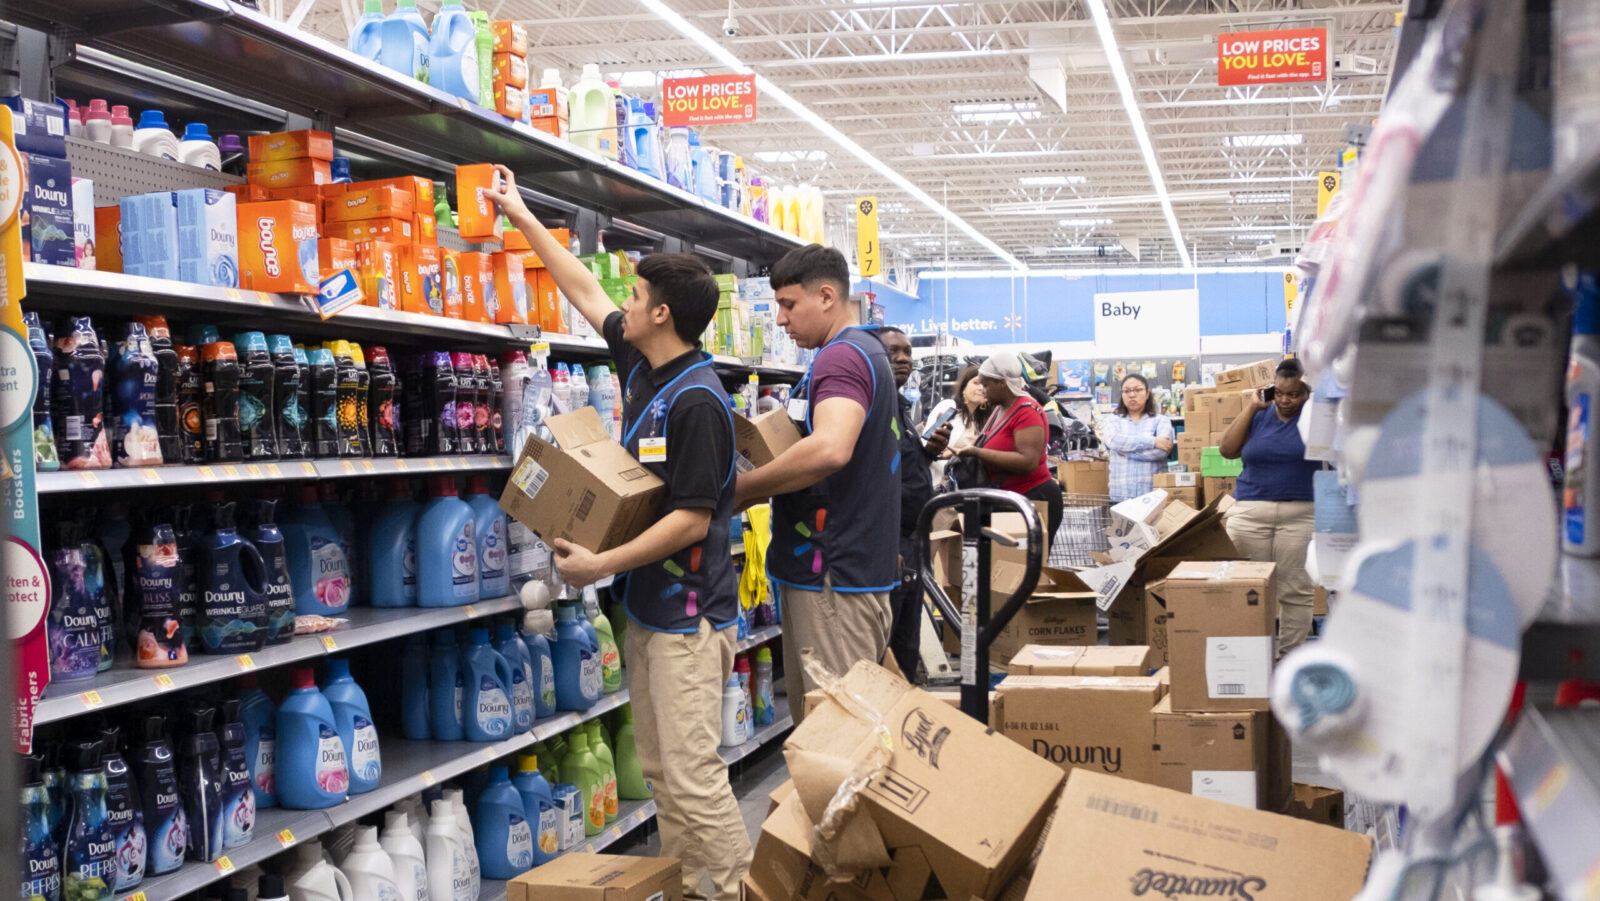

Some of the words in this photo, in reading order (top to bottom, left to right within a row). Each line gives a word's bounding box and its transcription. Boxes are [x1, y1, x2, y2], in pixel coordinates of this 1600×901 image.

[1222, 41, 1260, 56] LOW
[1263, 37, 1320, 53] PRICES
[1222, 55, 1258, 70] YOU
[1263, 52, 1310, 68] LOVE.
[667, 85, 699, 98] LOW
[702, 82, 751, 96] PRICES
[667, 98, 698, 112] YOU
[703, 97, 742, 110] LOVE.
[34, 184, 68, 208] Downy
[73, 222, 91, 238] wny
[210, 228, 235, 247] Downy
[292, 223, 317, 242] bounce
[258, 217, 281, 278] bounce
[865, 240, 873, 254] J
[417, 263, 440, 276] bounce
[864, 259, 873, 272] 7
[383, 250, 397, 310] bounce
[463, 274, 475, 305] bounce
[1101, 301, 1141, 320] Baby
[920, 319, 948, 333] Live
[951, 317, 998, 332] better.
[0, 366, 17, 377] tra
[0, 380, 19, 392] ent
[12, 448, 25, 520] Boosters
[319, 557, 346, 573] Downy
[6, 575, 29, 588] ften
[31, 575, 41, 587] &
[140, 576, 172, 589] Downy
[7, 590, 39, 603] otect
[143, 591, 171, 603] BLISS
[204, 589, 245, 604] Downy
[205, 603, 266, 617] WRINKLEGUARD
[63, 614, 97, 628] Downy
[1028, 626, 1052, 637] CORN
[1054, 624, 1087, 636] FLAKES
[63, 631, 100, 649] CALM
[479, 702, 510, 715] Downy
[17, 697, 31, 746] Fabric
[903, 710, 936, 757] Lysol
[357, 738, 378, 753] Downy
[322, 750, 345, 767] Downy
[1032, 738, 1122, 773] Downy
[156, 793, 179, 806] Downy
[107, 809, 133, 825] Downy
[29, 858, 59, 874] Downy
[80, 859, 117, 881] REFRES
[21, 874, 61, 898] REFRES
[1133, 867, 1268, 901] Suavitel
